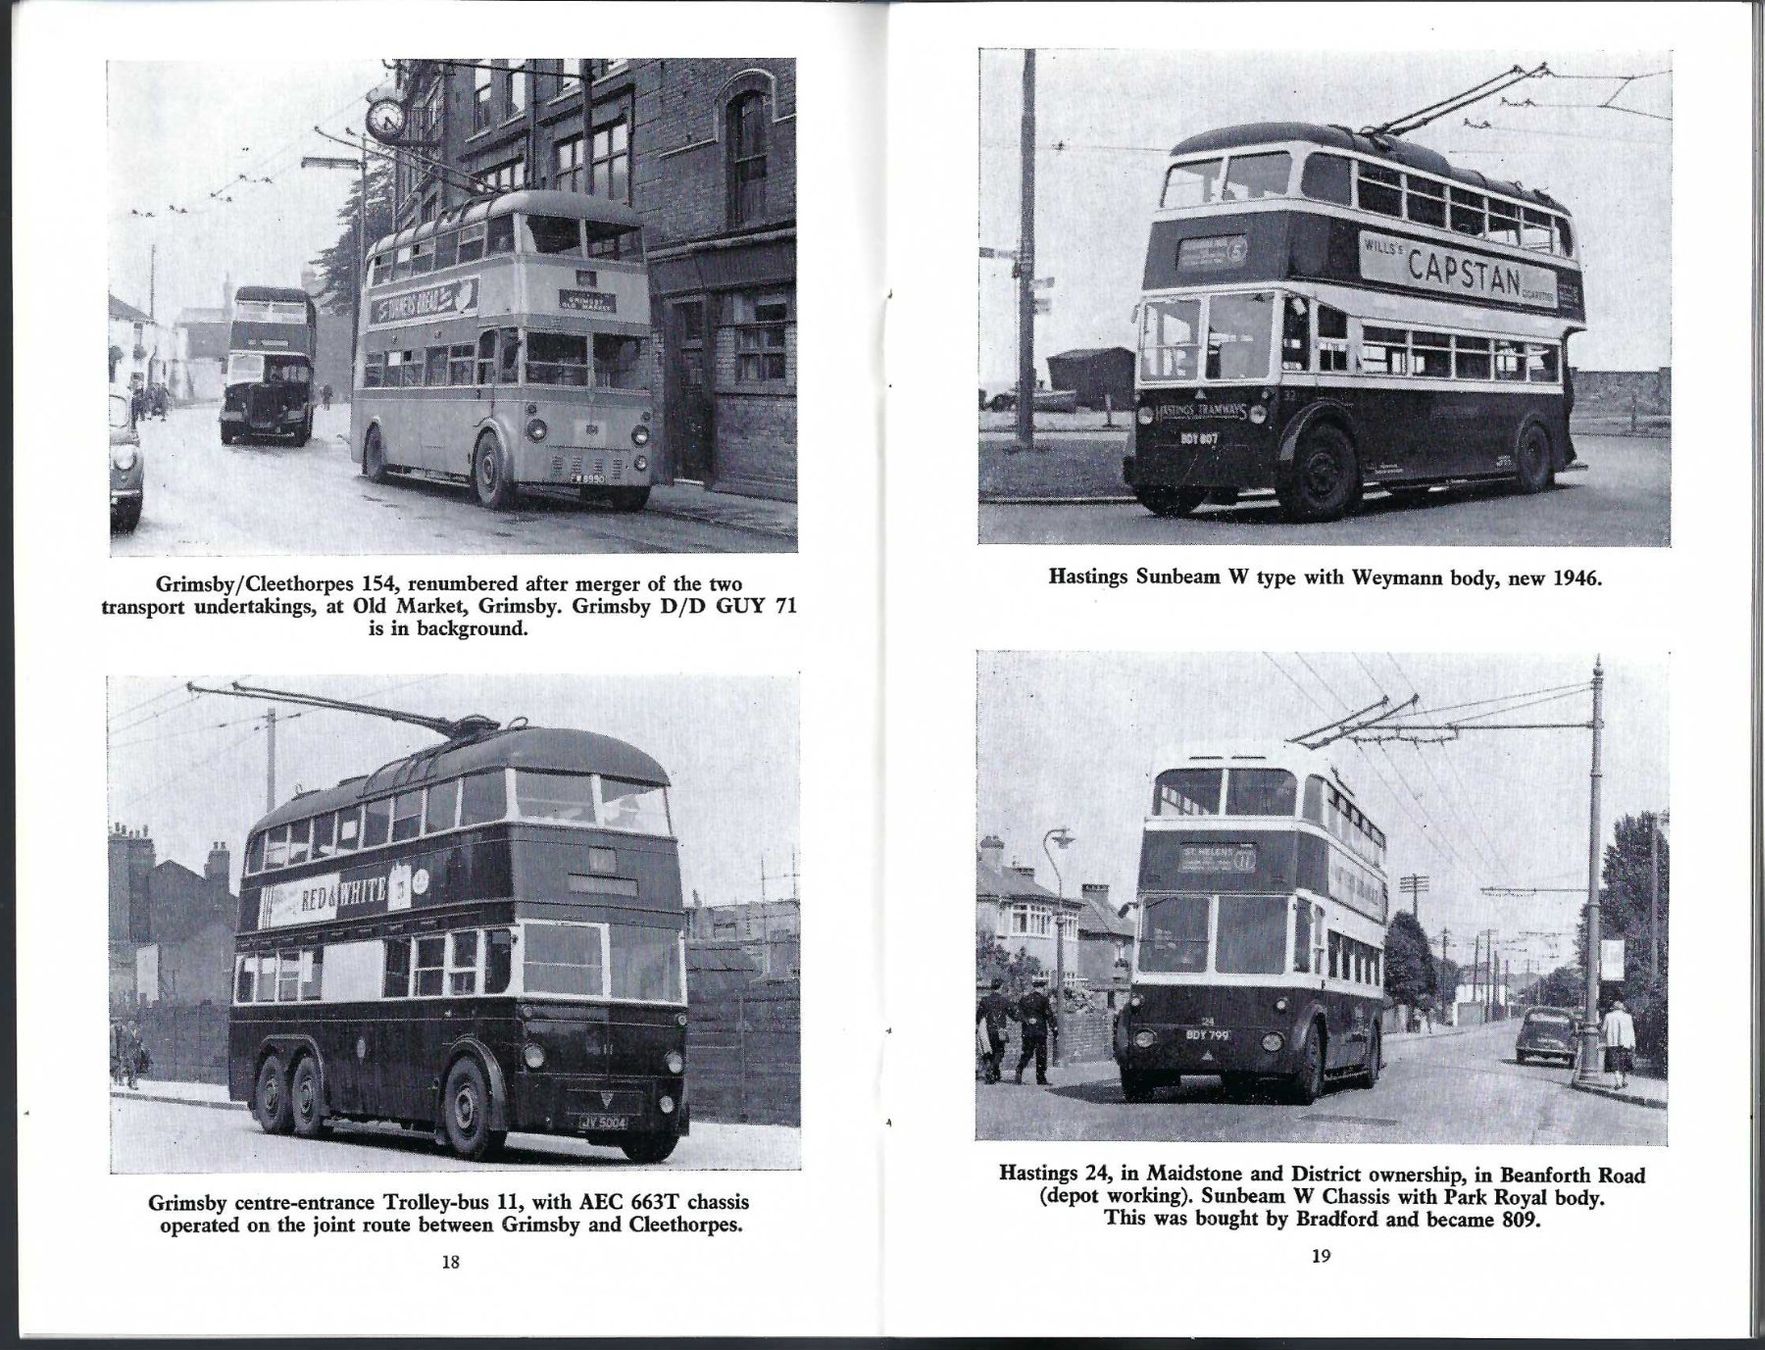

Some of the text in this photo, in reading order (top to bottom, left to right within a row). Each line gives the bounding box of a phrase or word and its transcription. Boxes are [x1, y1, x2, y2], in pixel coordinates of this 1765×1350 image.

[1408, 249, 1521, 296] CAPSTAN
[156, 575, 742, 596] Grimsby/Cleethorpes 154, renumbered after merger of the two
[1049, 567, 1602, 590] Hastings Sunbeam W type with Weymann body, new 1946.
[102, 597, 796, 619] transport undertakings, at Old Market, Grimsby. Grimsby D/D GUY 71
[369, 620, 528, 640] is in background.
[303, 887, 326, 912] RED
[338, 877, 387, 906] WHITE
[1186, 1030, 1228, 1040] BDY 799
[582, 1117, 625, 1129] JV 5004
[1000, 1164, 1645, 1187] Hastings 24, in Maidstone and District ownership, in Beanforth Road
[149, 1193, 749, 1215] Grimsby centre-entrance Trolley-bus 11, with AEC 663T chassis
[1040, 1186, 1604, 1210] (depot working). Sunbeam W Chassis with Park Royal body.
[160, 1215, 742, 1237] operated on the joint route between Grimsby and Cleethorpes.
[1104, 1209, 1540, 1230] This was bought by Bradford and became 809.
[443, 1255, 459, 1269] 18
[1313, 1249, 1331, 1263] 19
